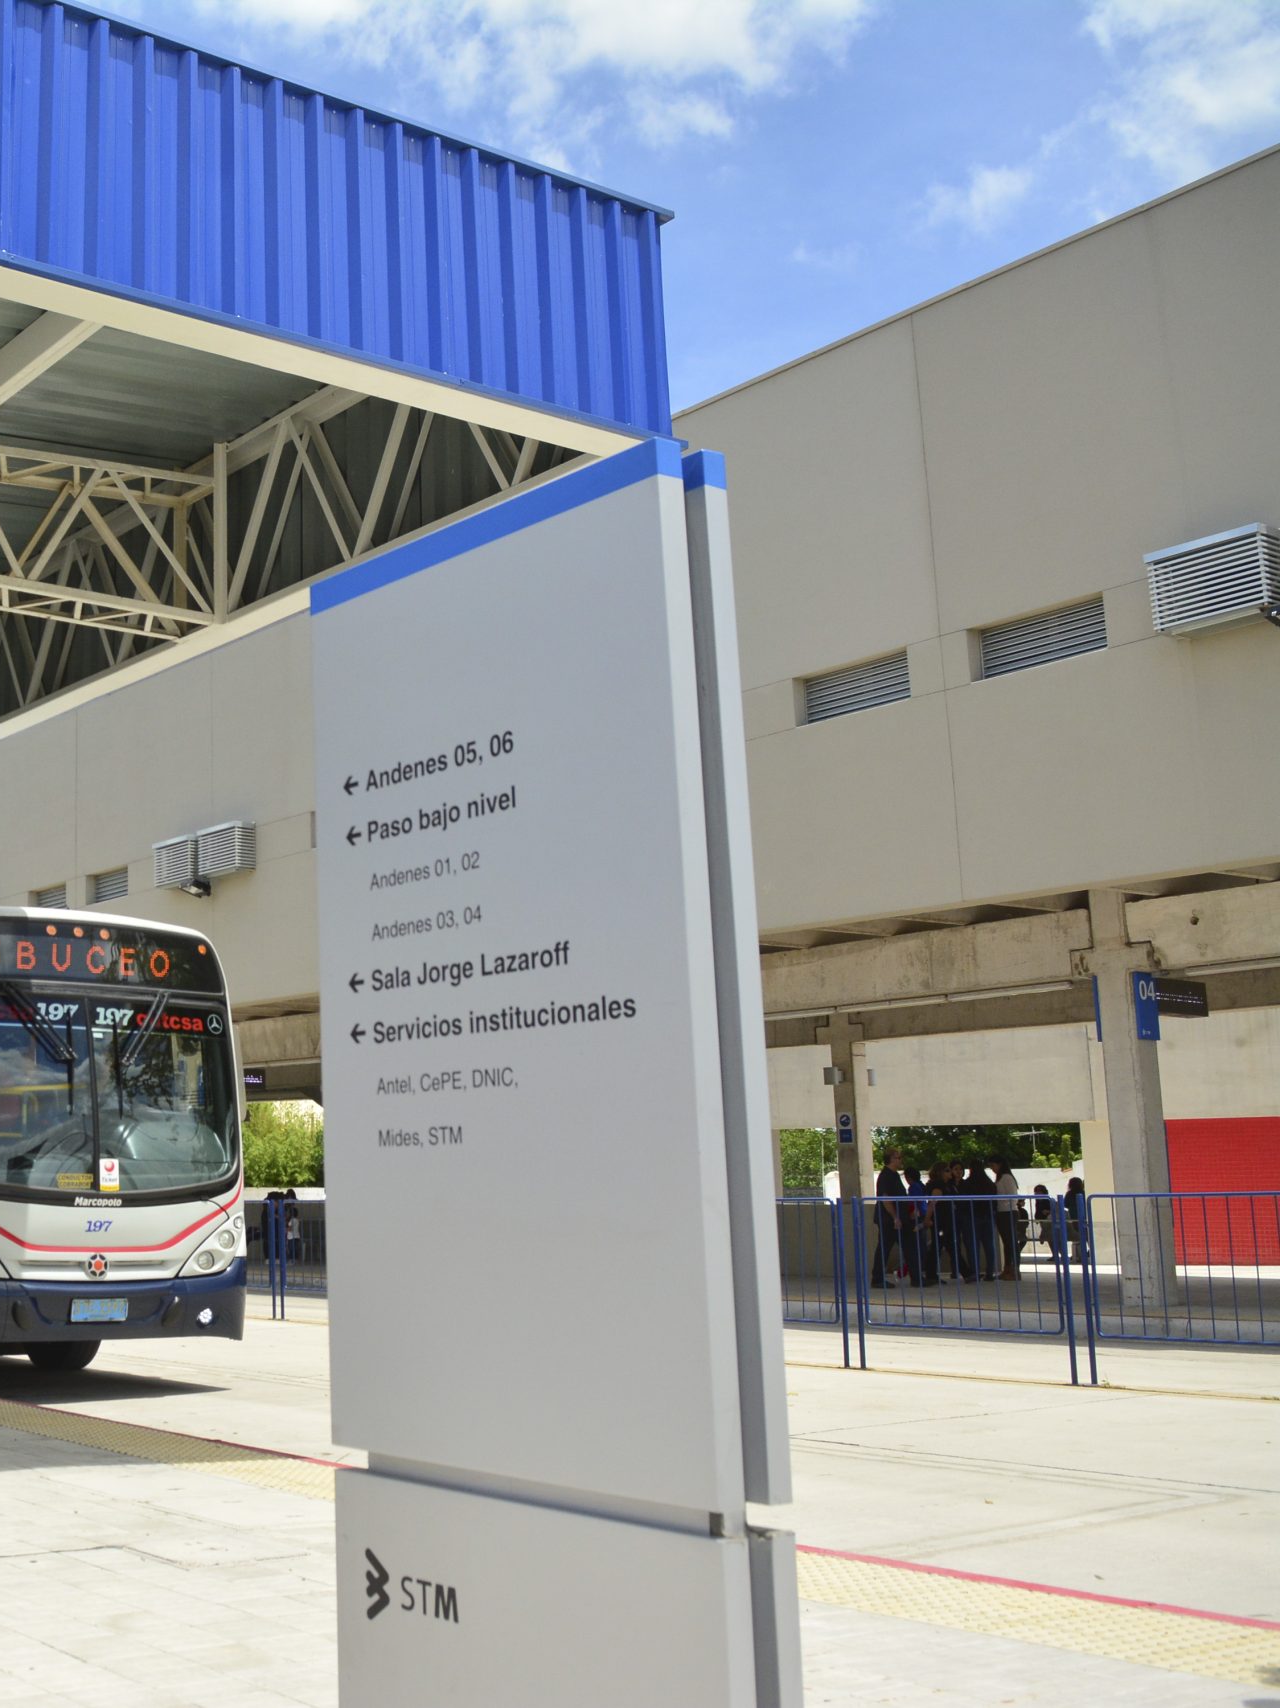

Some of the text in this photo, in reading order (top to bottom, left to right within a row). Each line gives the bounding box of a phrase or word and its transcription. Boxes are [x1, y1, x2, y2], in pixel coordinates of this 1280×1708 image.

[365, 730, 514, 792] Andenes 05, 06
[367, 785, 517, 842] Paso bajo nivel
[370, 850, 480, 891] Andenes 01, 02
[372, 904, 482, 941] Andenes 03, 04
[371, 940, 570, 991] Sala Jorge Lazaroff
[1139, 979, 1156, 1000] 04
[36, 1002, 79, 1021] 197
[95, 1006, 134, 1026] 197
[373, 995, 637, 1044] Servicios institucionales
[376, 1067, 519, 1095] Antel, CePE, DNIC,
[378, 1125, 463, 1148] Mides, STM
[74, 1196, 122, 1208] Marcopolo
[85, 1220, 112, 1233] 197
[401, 1575, 459, 1624] STM
